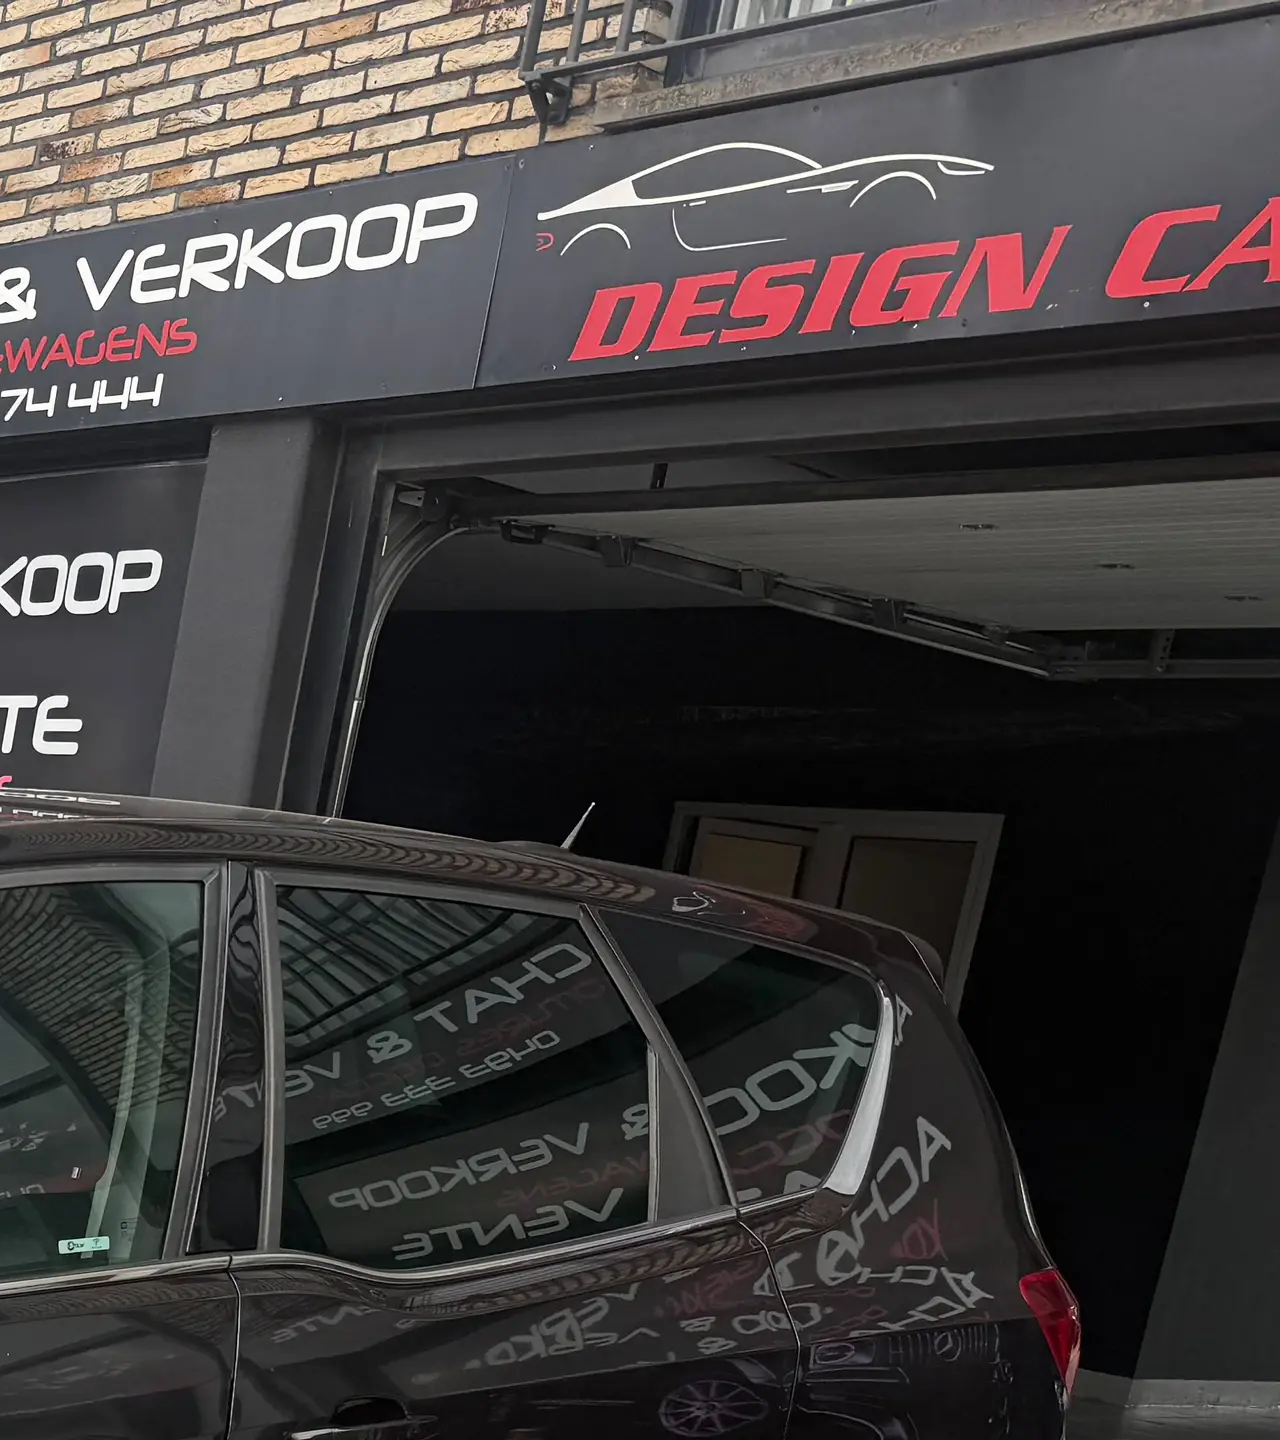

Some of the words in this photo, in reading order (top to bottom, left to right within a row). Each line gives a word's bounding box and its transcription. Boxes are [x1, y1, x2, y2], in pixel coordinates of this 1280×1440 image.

[76, 192, 479, 311] VERKOOP
[569, 226, 1073, 362] DESIGN
[67, 373, 164, 417] 444
